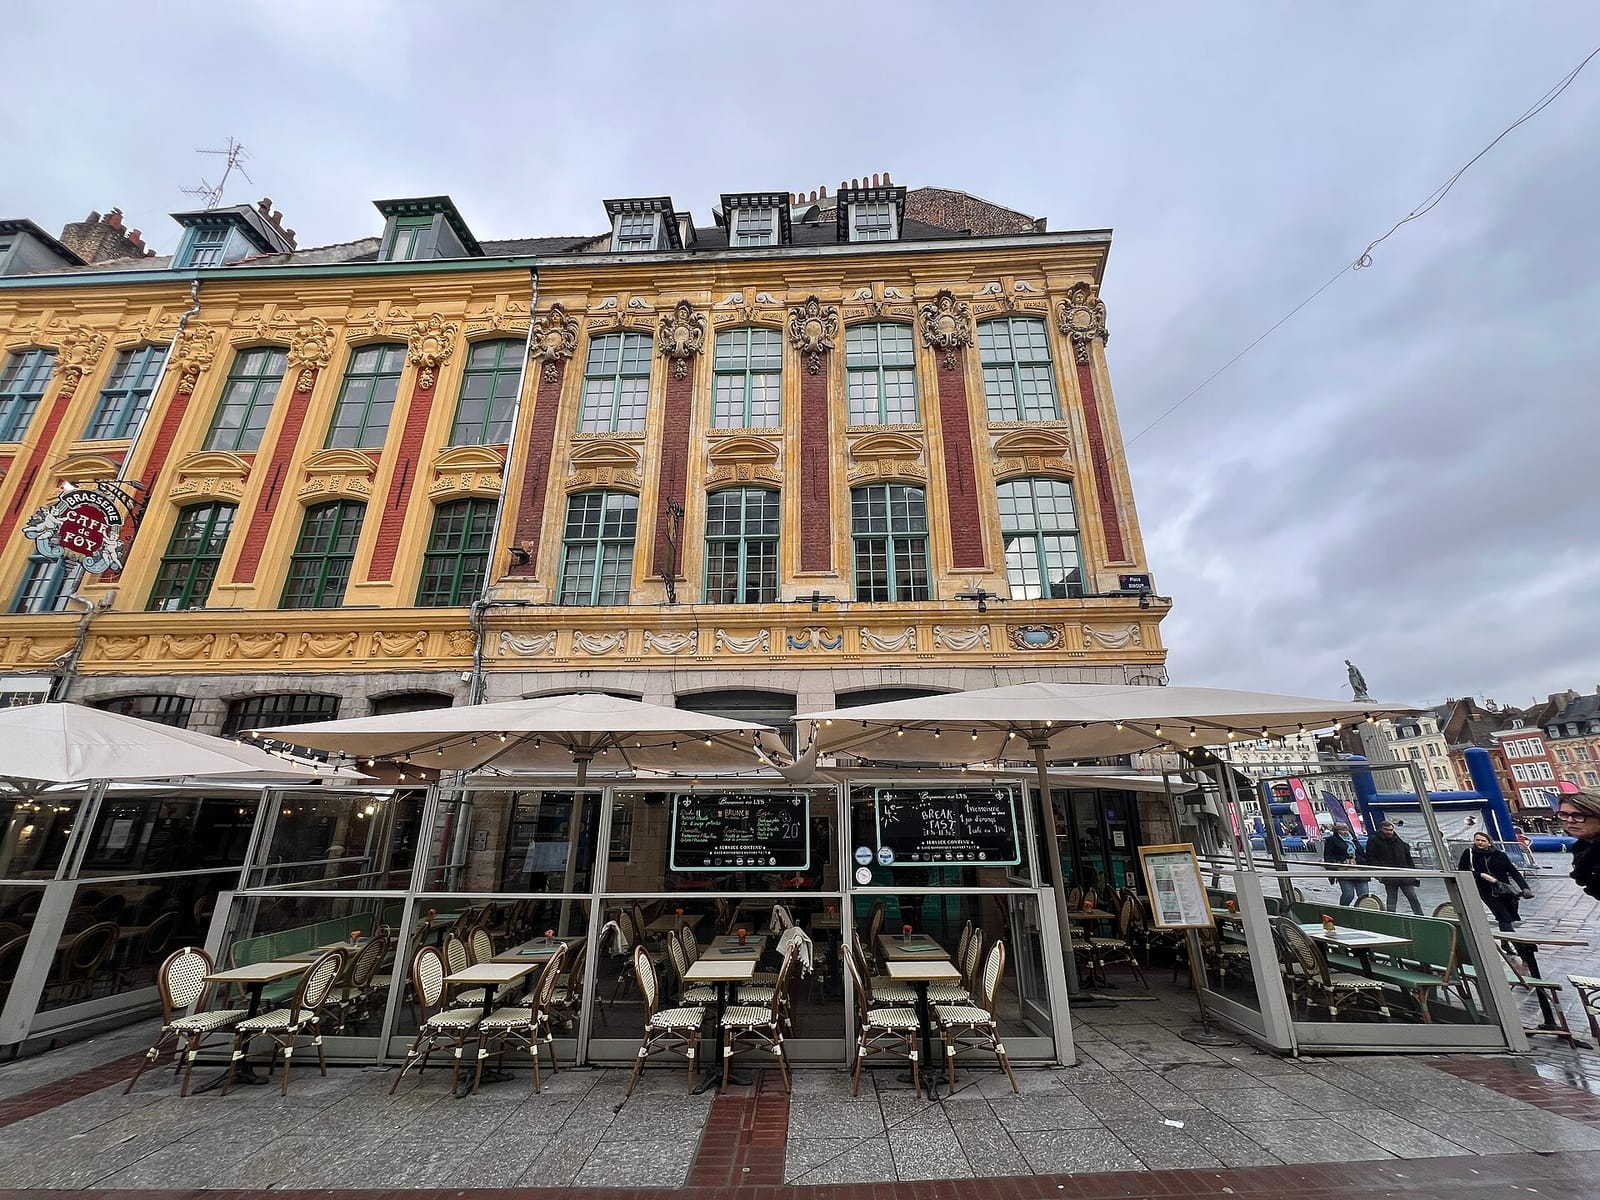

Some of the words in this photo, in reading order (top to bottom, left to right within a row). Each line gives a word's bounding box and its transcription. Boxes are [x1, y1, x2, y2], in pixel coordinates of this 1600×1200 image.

[66, 493, 118, 522] BRASSERIE
[78, 527, 90, 536] de
[64, 532, 96, 551] FOY
[930, 820, 956, 829] FAST
